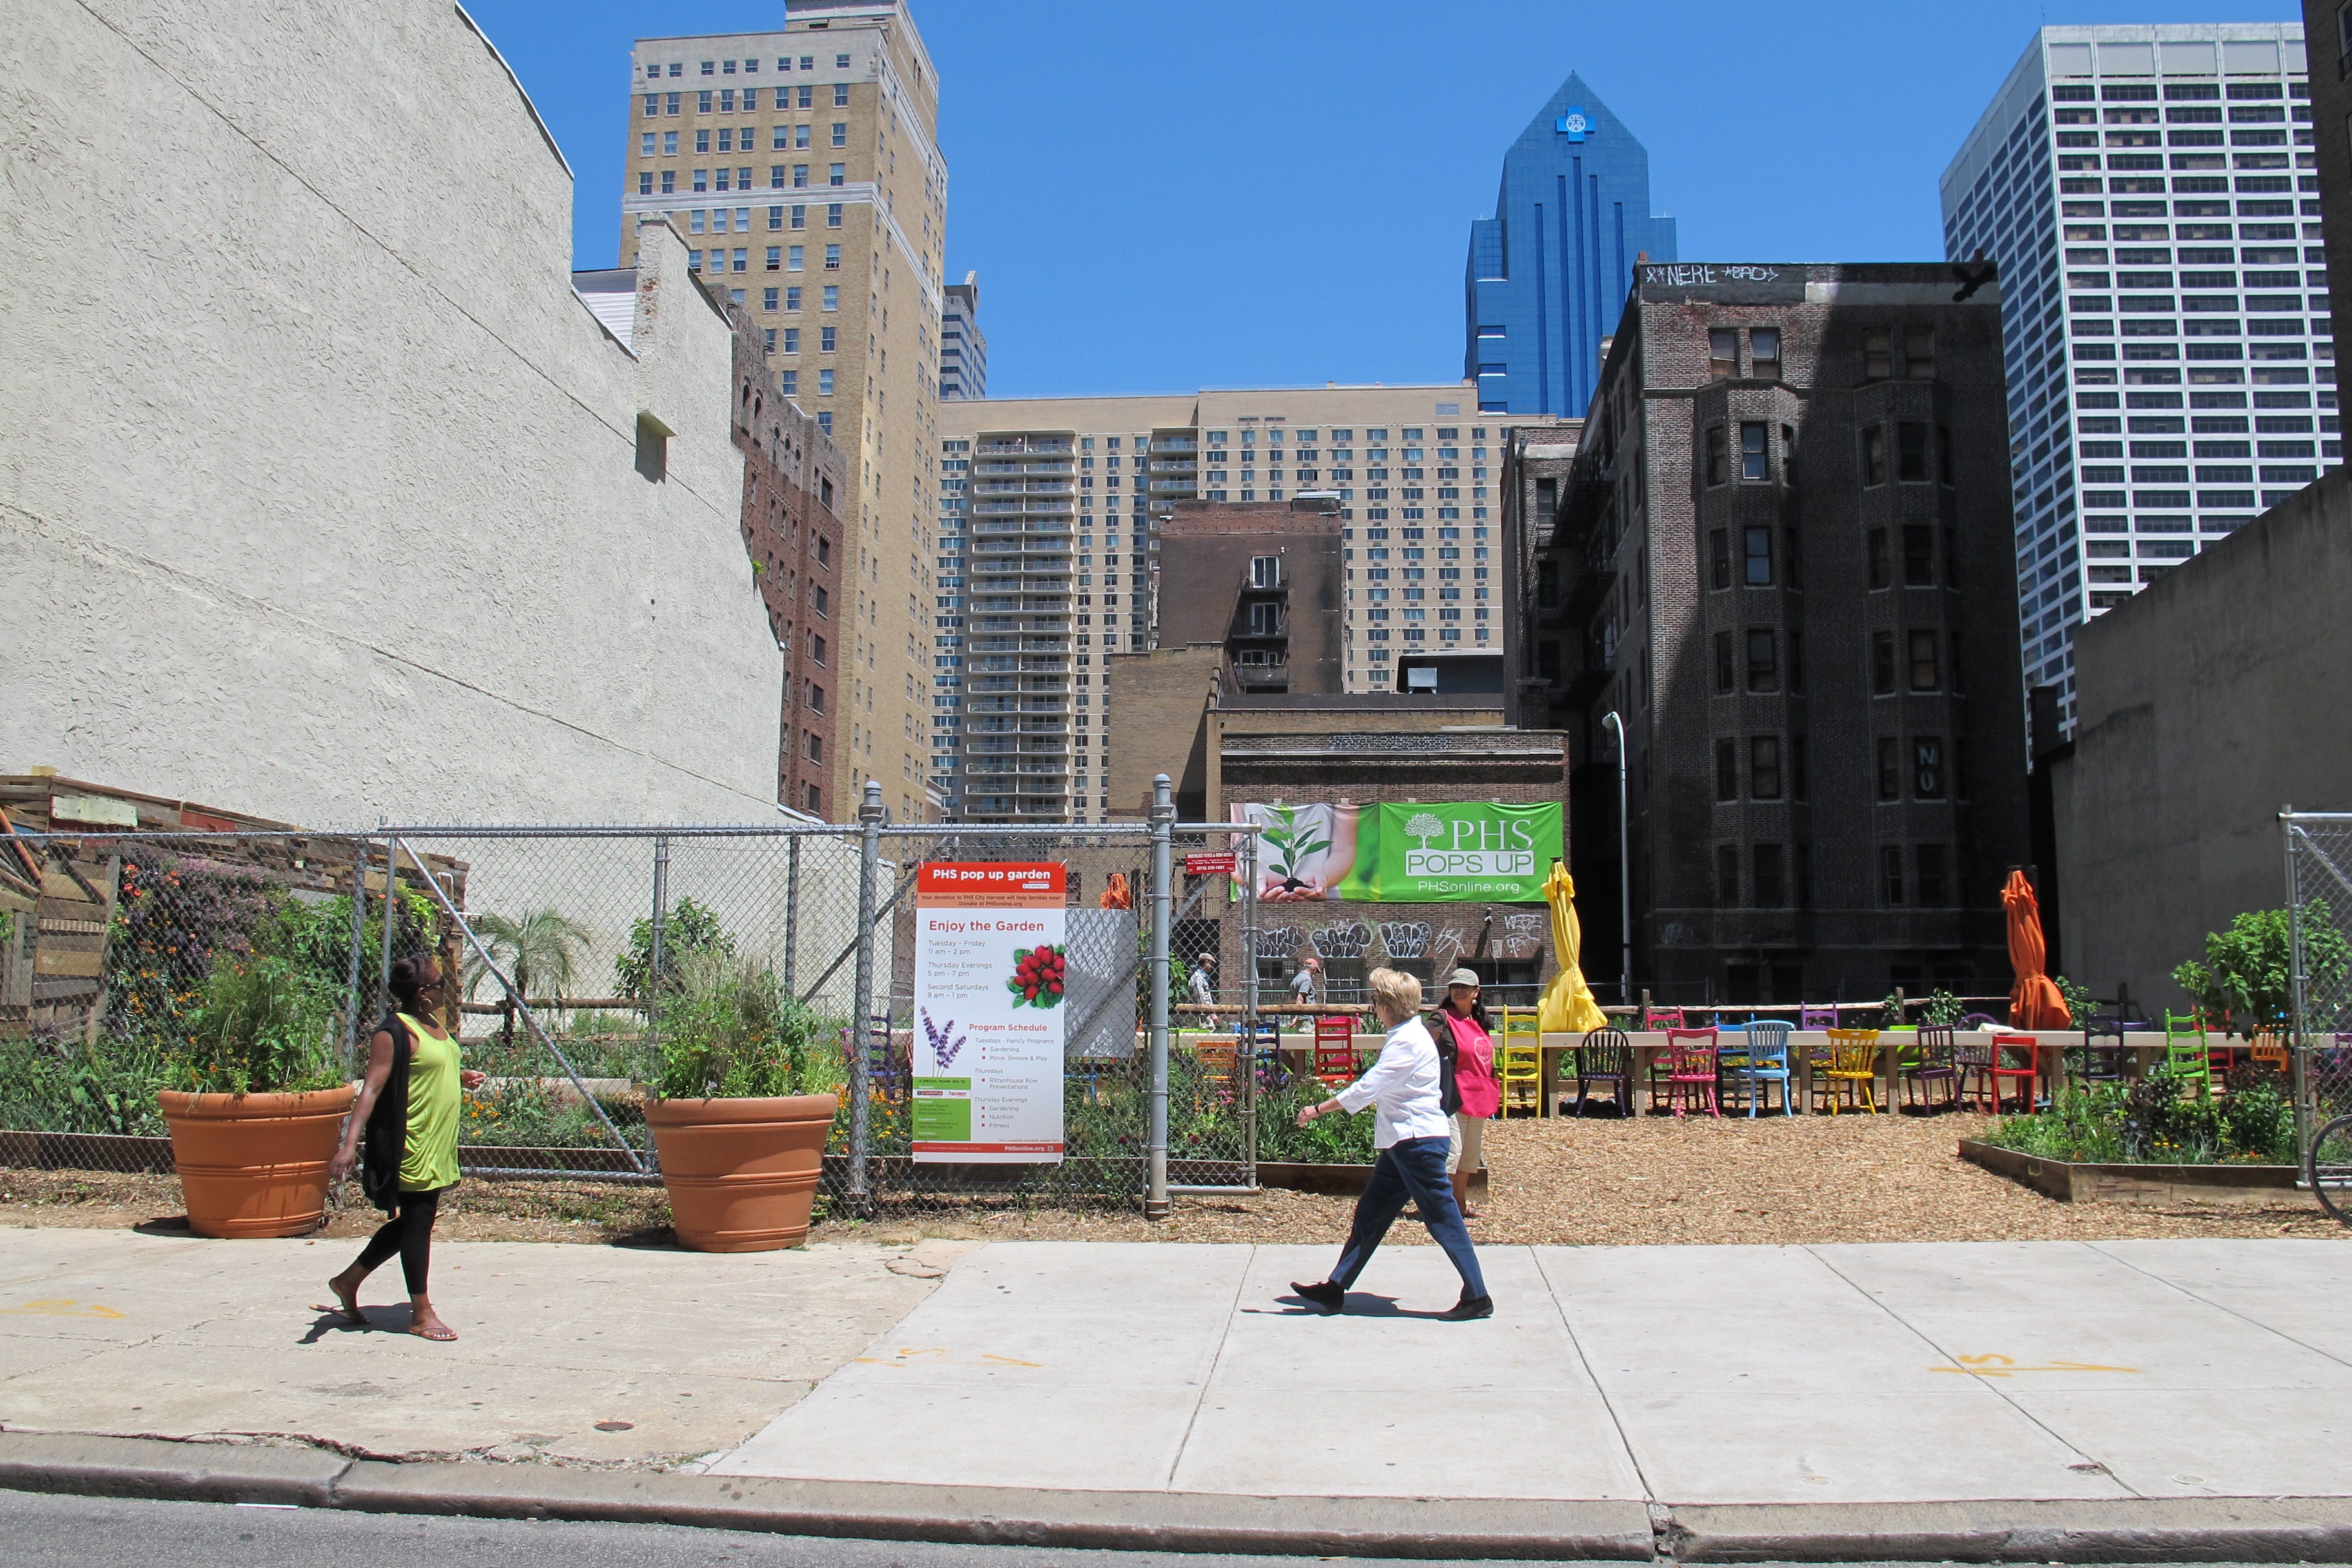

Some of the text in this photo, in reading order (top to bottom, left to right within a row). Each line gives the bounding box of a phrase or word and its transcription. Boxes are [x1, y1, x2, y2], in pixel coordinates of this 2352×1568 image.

[1450, 819, 1534, 850] PHS
[1407, 854, 1532, 874] POPS UP
[933, 869, 1051, 881] PHS pop up garden
[1418, 881, 1520, 894] PHSonline.org
[929, 920, 1044, 933] Enjoy the Garden
[969, 1023, 1006, 1032] Program
